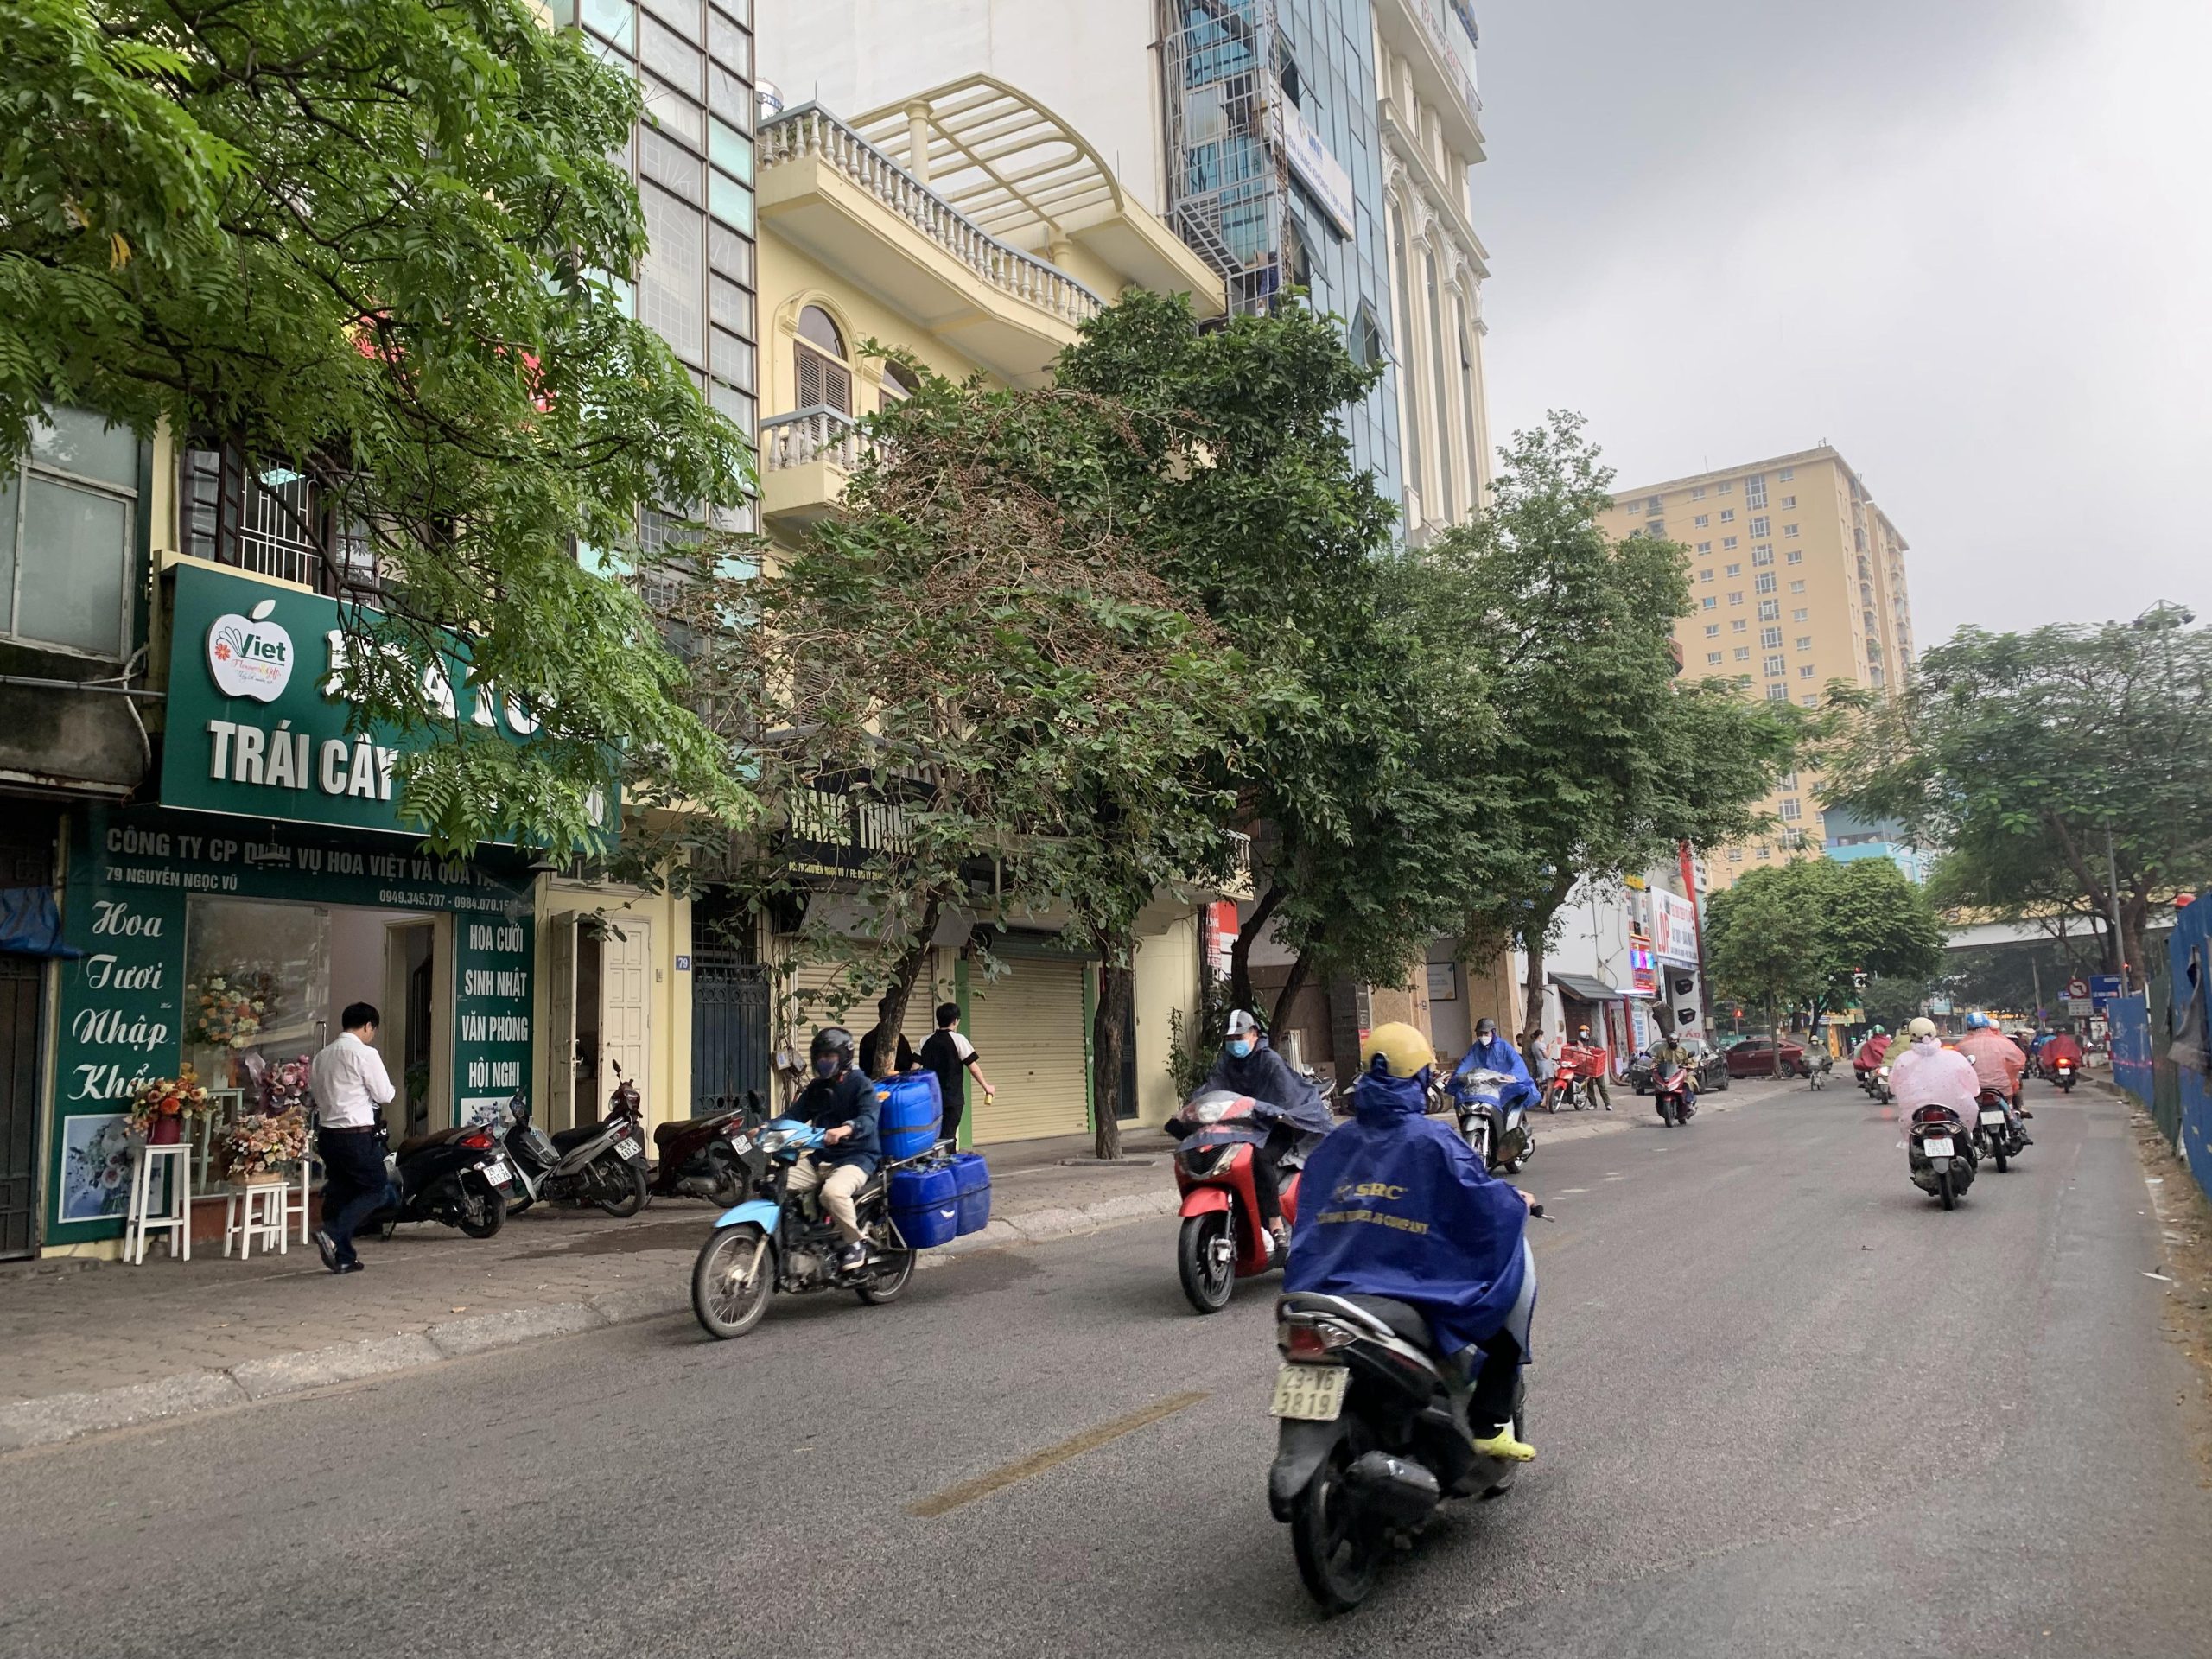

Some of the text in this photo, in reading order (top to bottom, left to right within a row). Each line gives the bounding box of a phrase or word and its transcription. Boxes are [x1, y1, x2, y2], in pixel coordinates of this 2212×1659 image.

[239, 633, 286, 662] Viet
[207, 720, 309, 790] TRÁI
[319, 733, 400, 802] CÂY
[106, 824, 170, 857] CÔNG
[177, 835, 203, 860] TY
[209, 839, 238, 862] CP
[244, 842, 291, 870] DỊH
[297, 847, 321, 875] VỤ
[327, 850, 364, 875] HOA
[370, 852, 406, 882] VIỆT
[411, 856, 433, 880] VÀ
[105, 866, 238, 892] 79 NGUYỄN NGỌC VŨ
[379, 889, 446, 907] 0949.345.707
[92, 900, 163, 938] Hoa
[469, 922, 524, 953] HOA CƯỚI
[86, 954, 163, 990] Tươi
[677, 957, 689, 969] 79
[465, 967, 527, 1002] SINH NHẬT
[73, 1008, 169, 1052] Nhập
[461, 1009, 528, 1042] VĂN PHÒNG
[67, 1063, 164, 1101] Khẩ
[468, 1056, 520, 1093] HỘI NGHỊ
[1276, 1392, 1331, 1416] 3819
